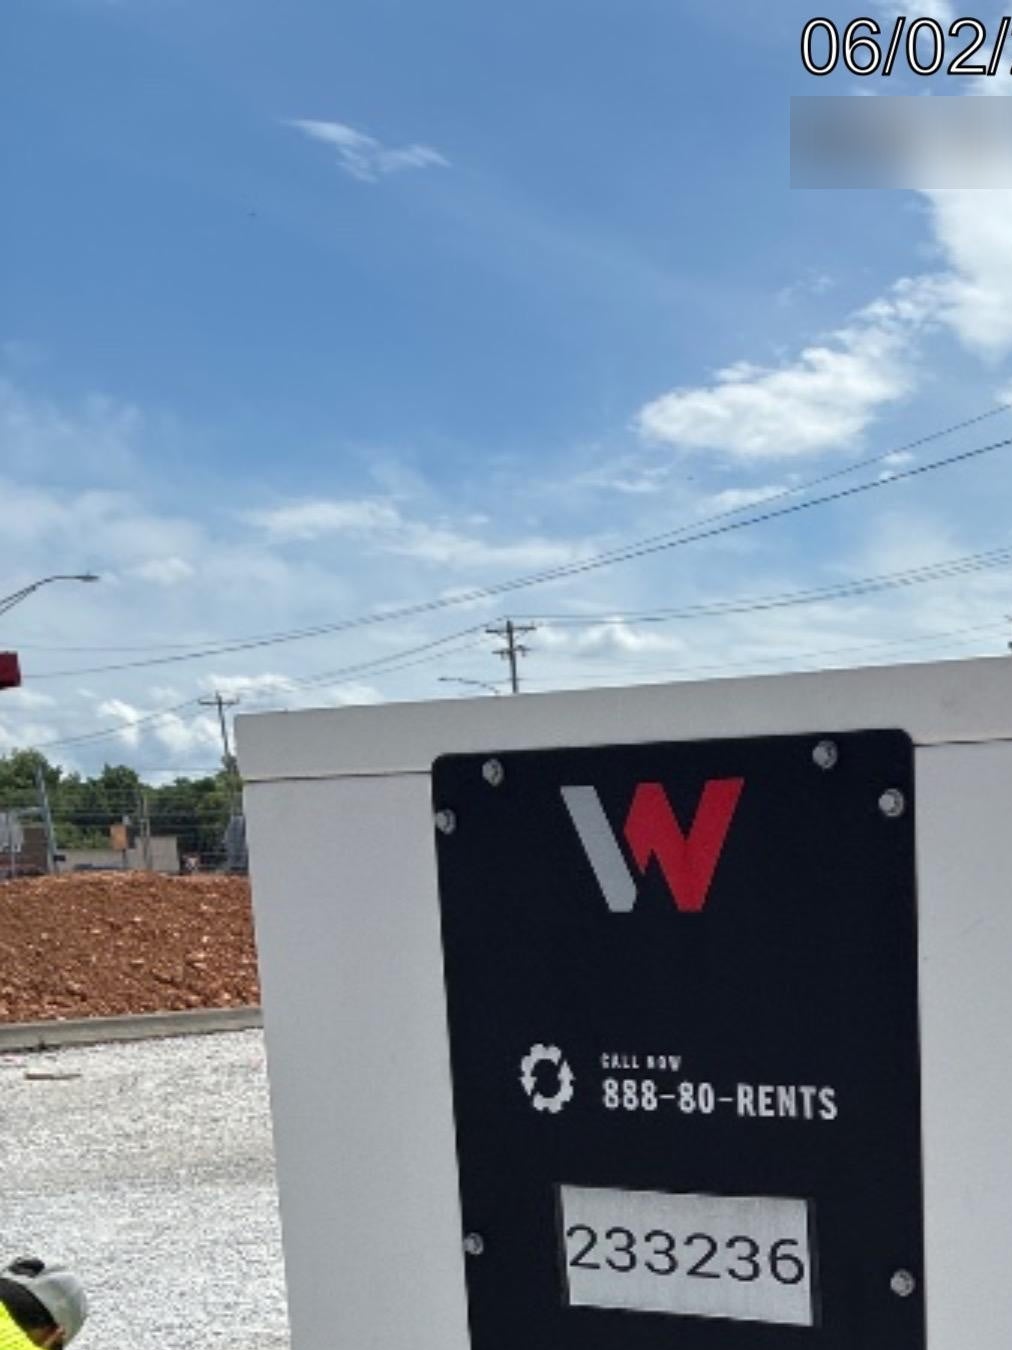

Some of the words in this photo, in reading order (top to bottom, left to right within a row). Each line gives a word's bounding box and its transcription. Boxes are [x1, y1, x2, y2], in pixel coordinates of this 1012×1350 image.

[601, 1052, 640, 1070] CALL
[602, 1077, 838, 1120] 888-80-RENTS
[566, 1224, 806, 1286] 233236
